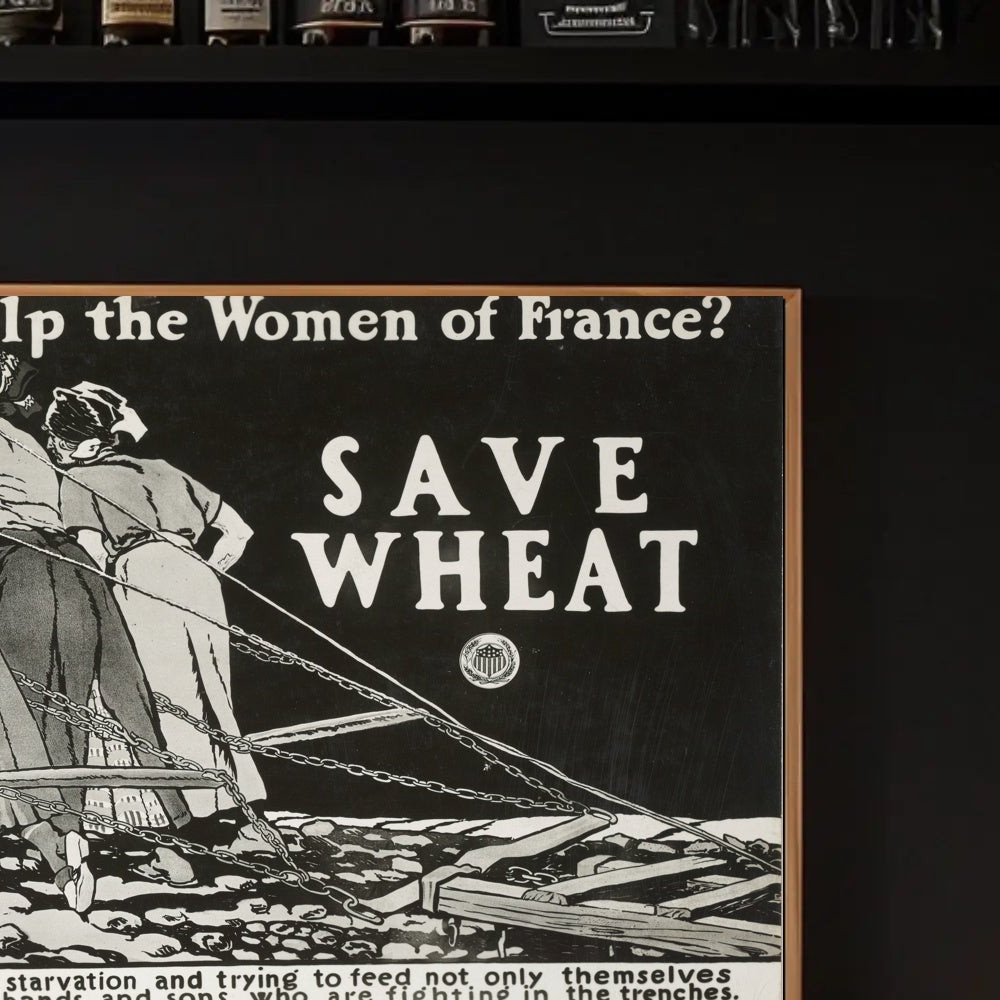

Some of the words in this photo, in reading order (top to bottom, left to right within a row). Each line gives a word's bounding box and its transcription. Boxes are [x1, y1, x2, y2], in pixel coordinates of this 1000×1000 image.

[85, 296, 188, 341] the
[205, 296, 418, 342] Women
[441, 296, 500, 341] of
[519, 296, 732, 341] France?
[321, 434, 648, 517] SAVE
[291, 527, 699, 613] WHEAT
[6, 971, 137, 992] starvation
[156, 970, 203, 991] and
[217, 967, 299, 991] trying
[314, 969, 342, 988] to
[351, 968, 411, 987] feed
[426, 967, 469, 986] not
[485, 967, 543, 989] only
[562, 965, 731, 985] themselves
